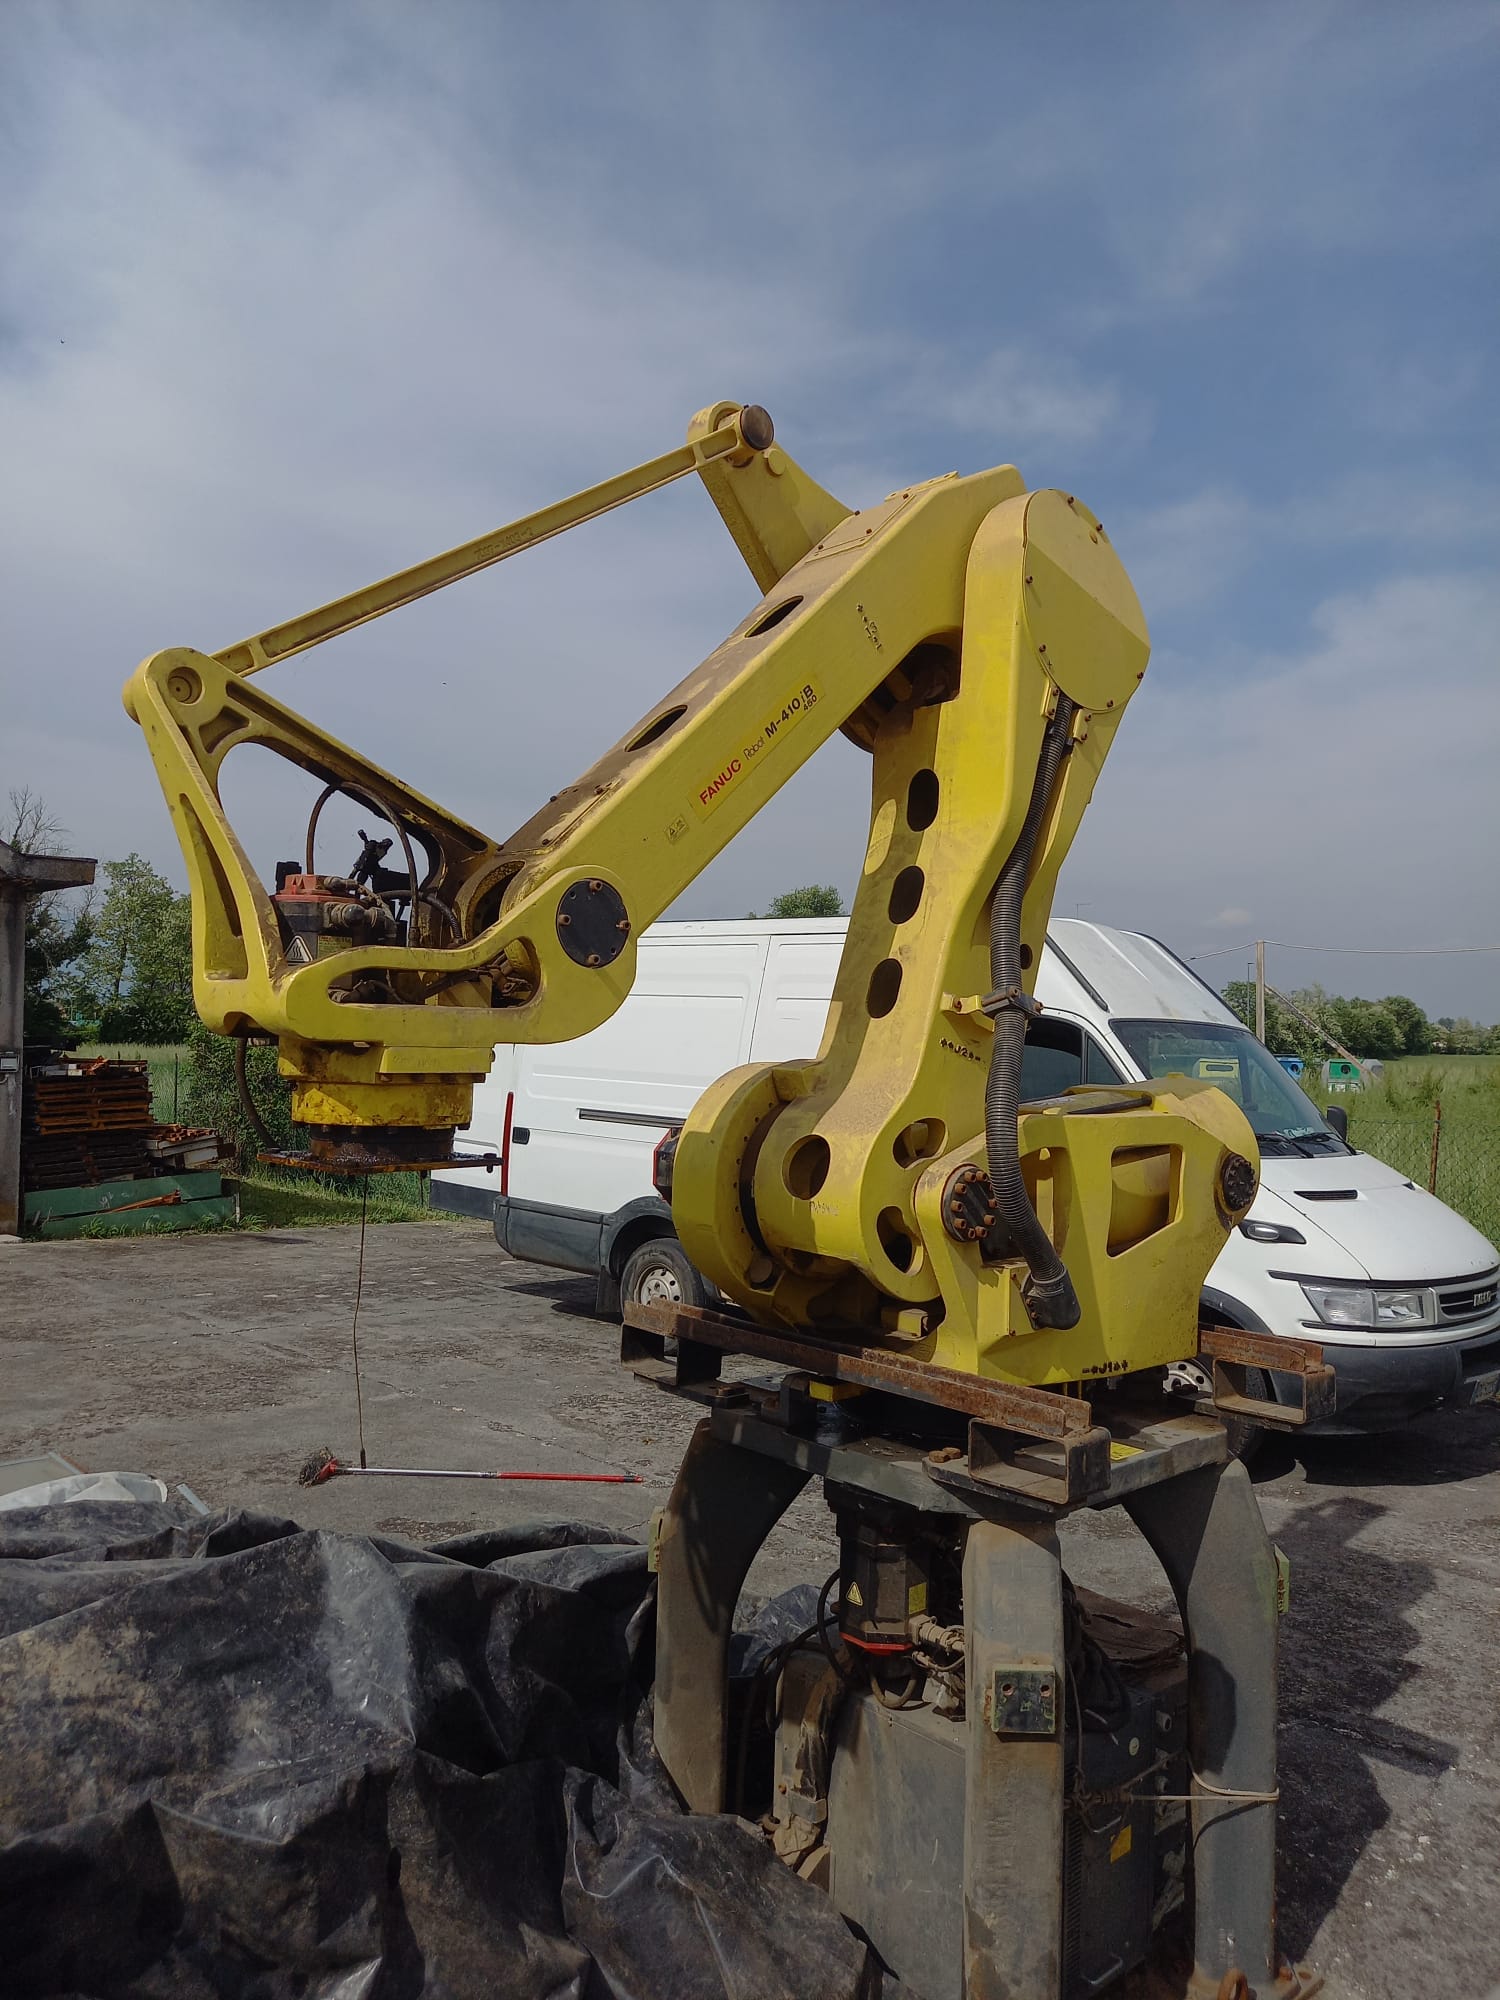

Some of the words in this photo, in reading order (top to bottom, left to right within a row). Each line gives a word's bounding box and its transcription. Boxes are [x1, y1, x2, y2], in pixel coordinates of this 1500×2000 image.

[803, 694, 817, 711] 450
[699, 759, 742, 805] FANUC
[743, 736, 766, 760] Robot
